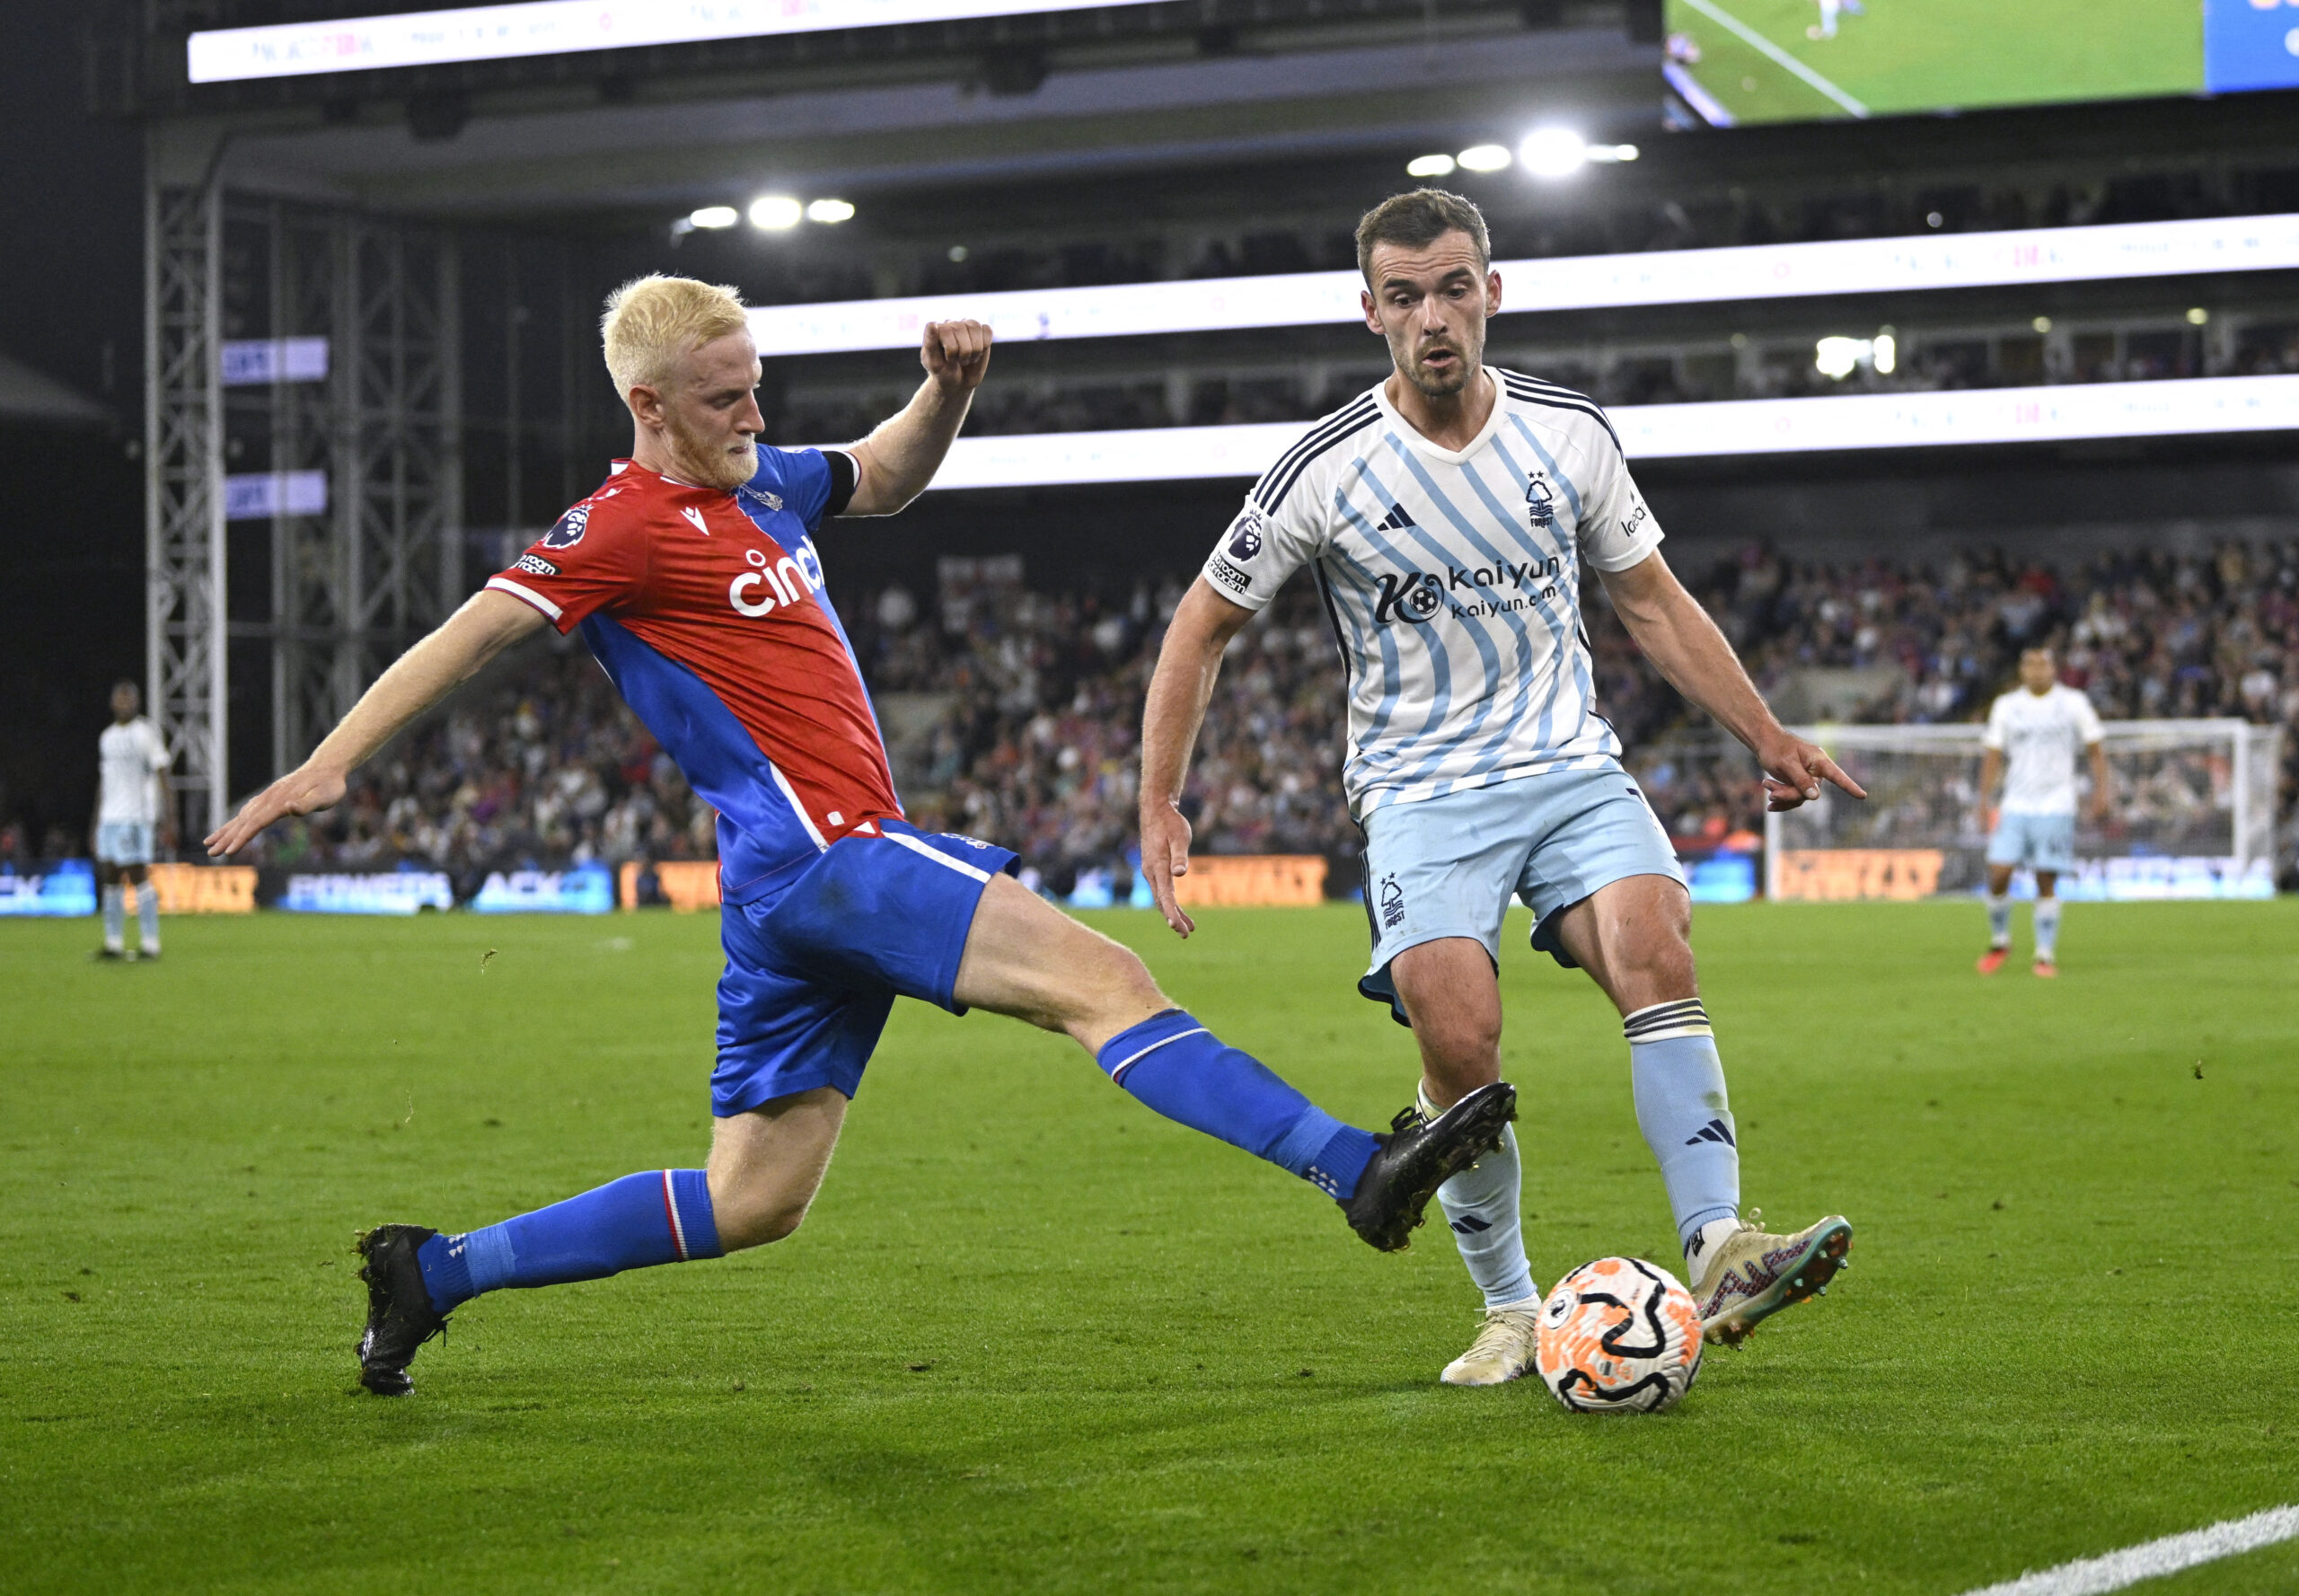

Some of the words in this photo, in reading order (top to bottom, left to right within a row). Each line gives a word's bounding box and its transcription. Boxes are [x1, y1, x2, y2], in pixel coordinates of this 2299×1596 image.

[524, 554, 556, 576] room
[1219, 560, 1246, 584] room
[1448, 556, 1561, 591] kaiyun
[1214, 568, 1246, 595] racism
[1451, 585, 1556, 620] kaiyun.cm
